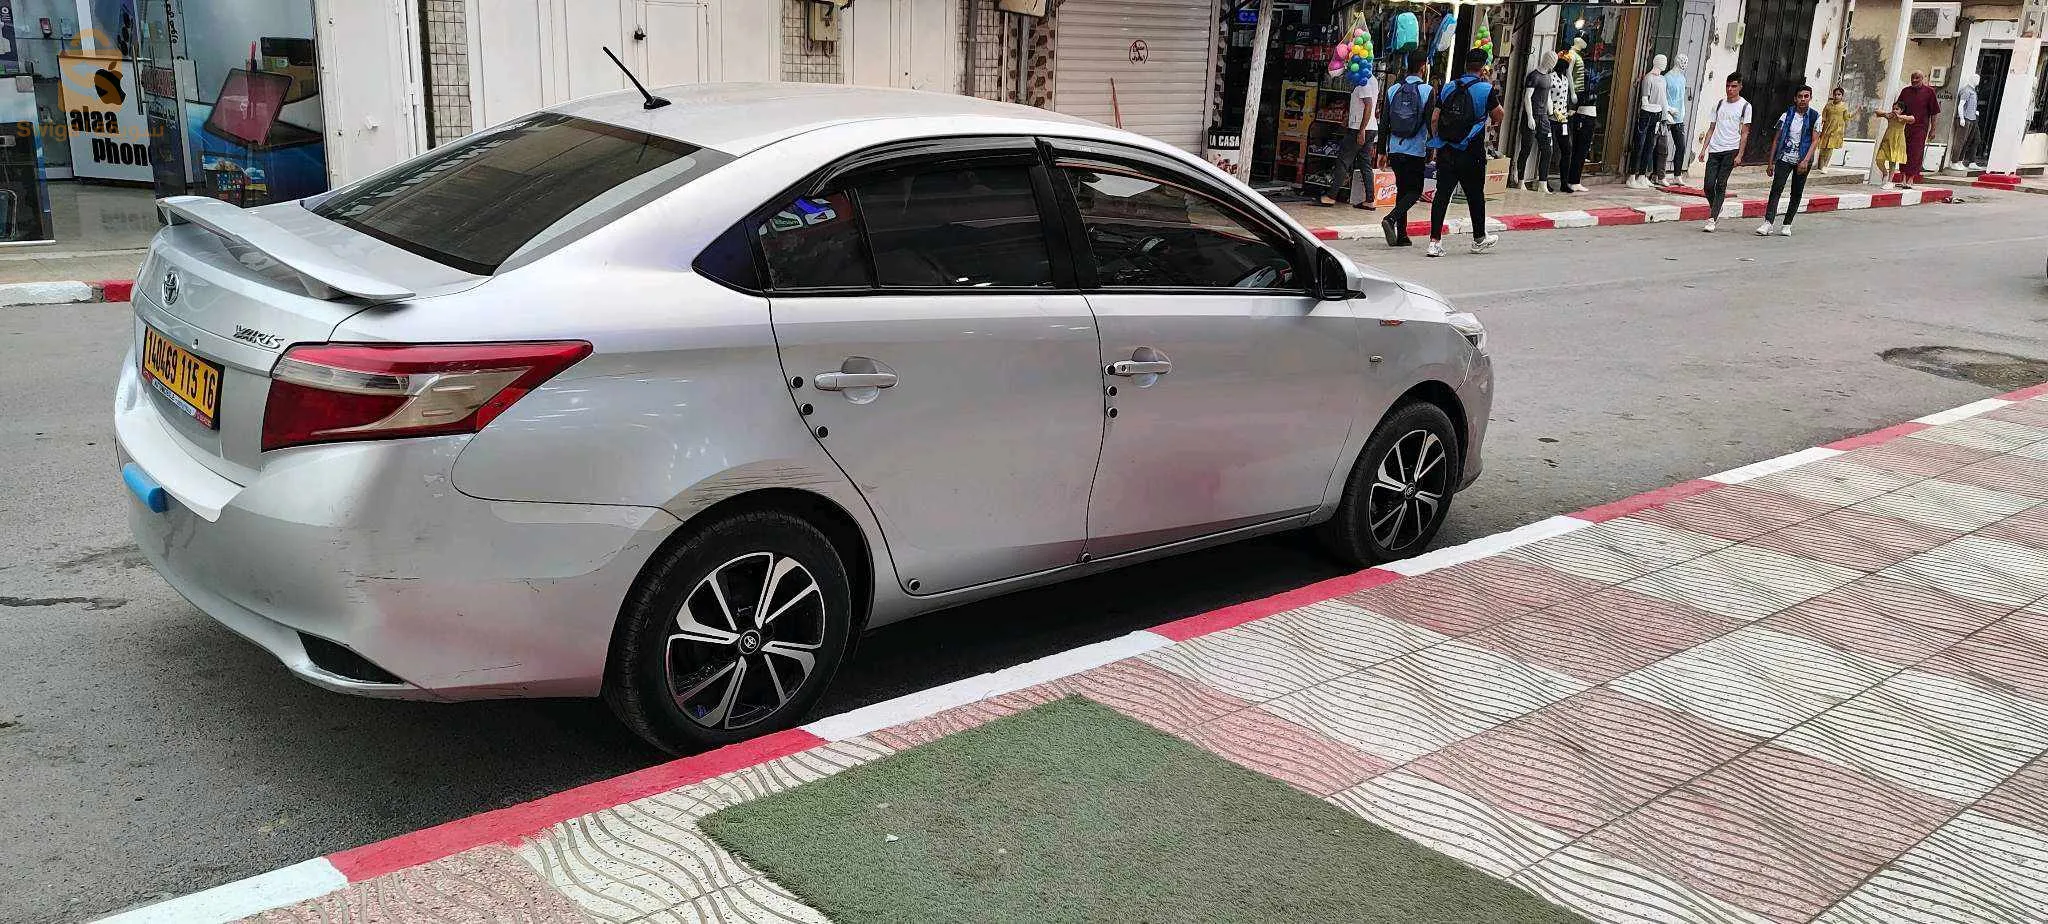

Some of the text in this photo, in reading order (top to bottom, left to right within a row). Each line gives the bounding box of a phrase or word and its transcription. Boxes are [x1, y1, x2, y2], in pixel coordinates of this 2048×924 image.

[70, 106, 120, 134] alaa
[1209, 135, 1240, 147] LA CASA
[147, 330, 178, 385] 140469
[181, 355, 200, 399] 115
[202, 369, 216, 410] 16
